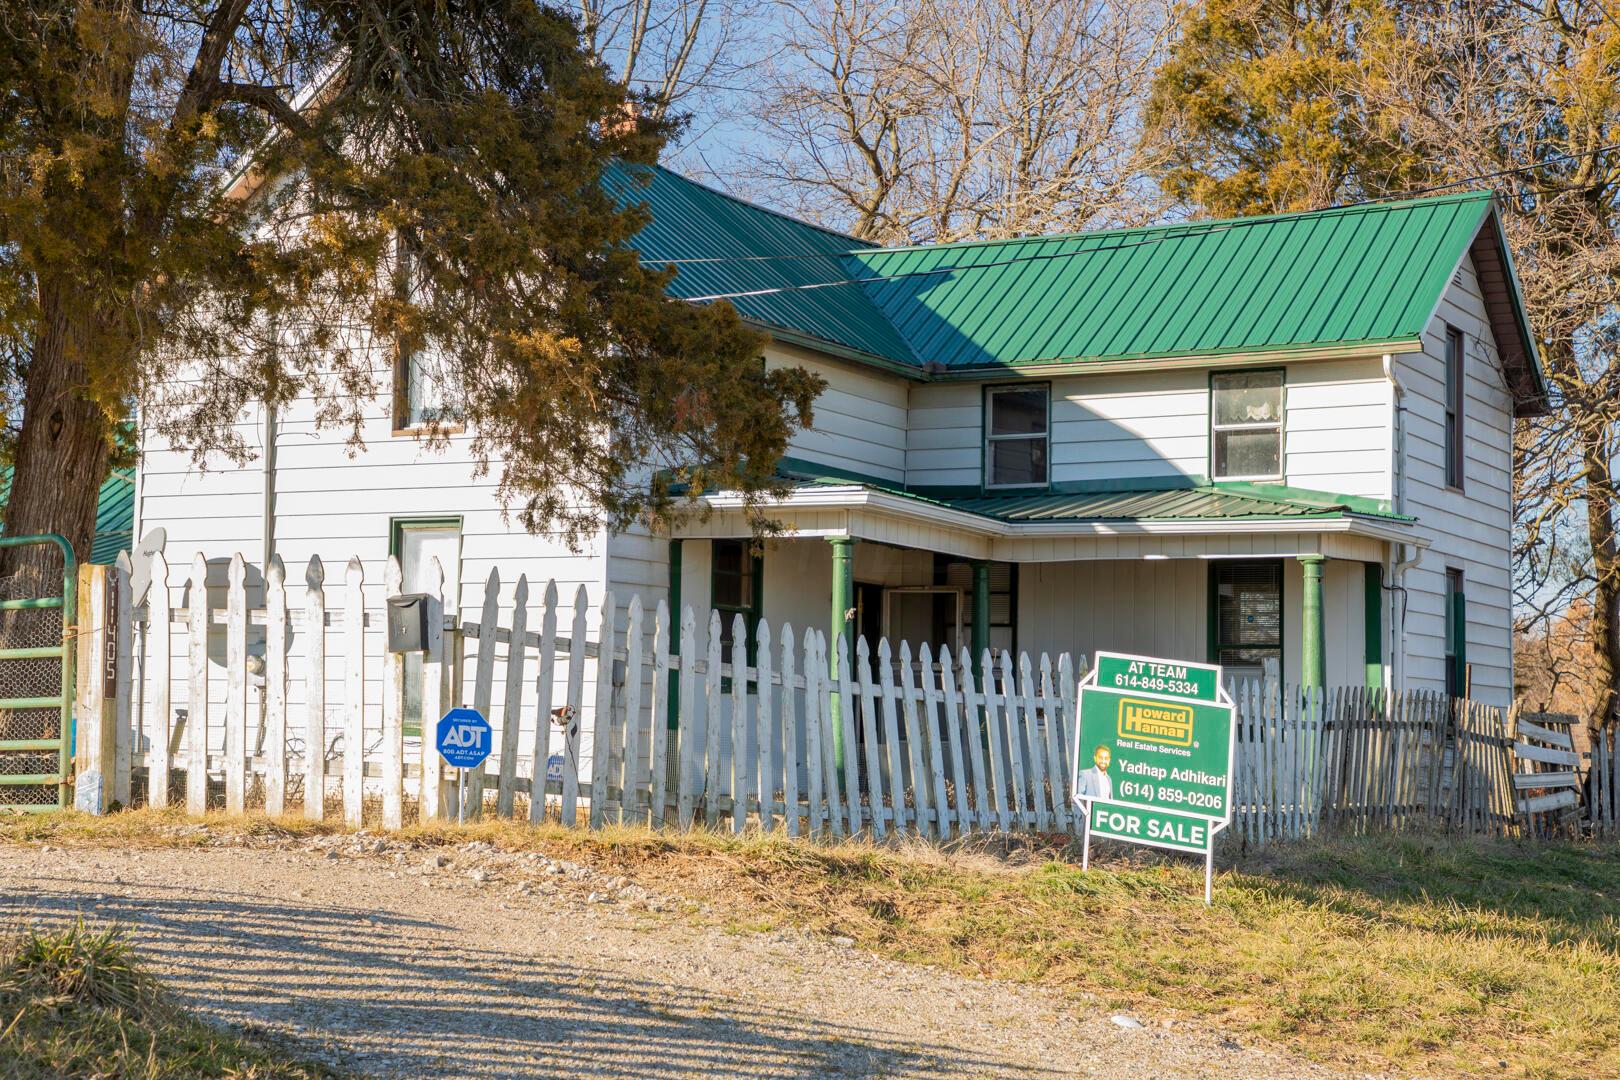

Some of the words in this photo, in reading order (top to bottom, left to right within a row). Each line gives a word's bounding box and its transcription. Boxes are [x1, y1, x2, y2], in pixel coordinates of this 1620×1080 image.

[1128, 661, 1145, 674] AT
[1150, 664, 1187, 680] TEAM
[1115, 673, 1199, 695] 614-849-5334
[1125, 706, 1186, 731] Howard
[441, 725, 487, 749] ADT
[1116, 739, 1133, 749] Real
[1134, 742, 1157, 752] Estate
[1159, 745, 1191, 757] Services
[1118, 759, 1167, 780] Yadhap
[1170, 767, 1226, 787] Adhikari
[1119, 780, 1154, 802] (614)
[1158, 787, 1222, 809] 859-0206
[1095, 810, 1140, 835] FOR
[1147, 818, 1204, 846] SALE
